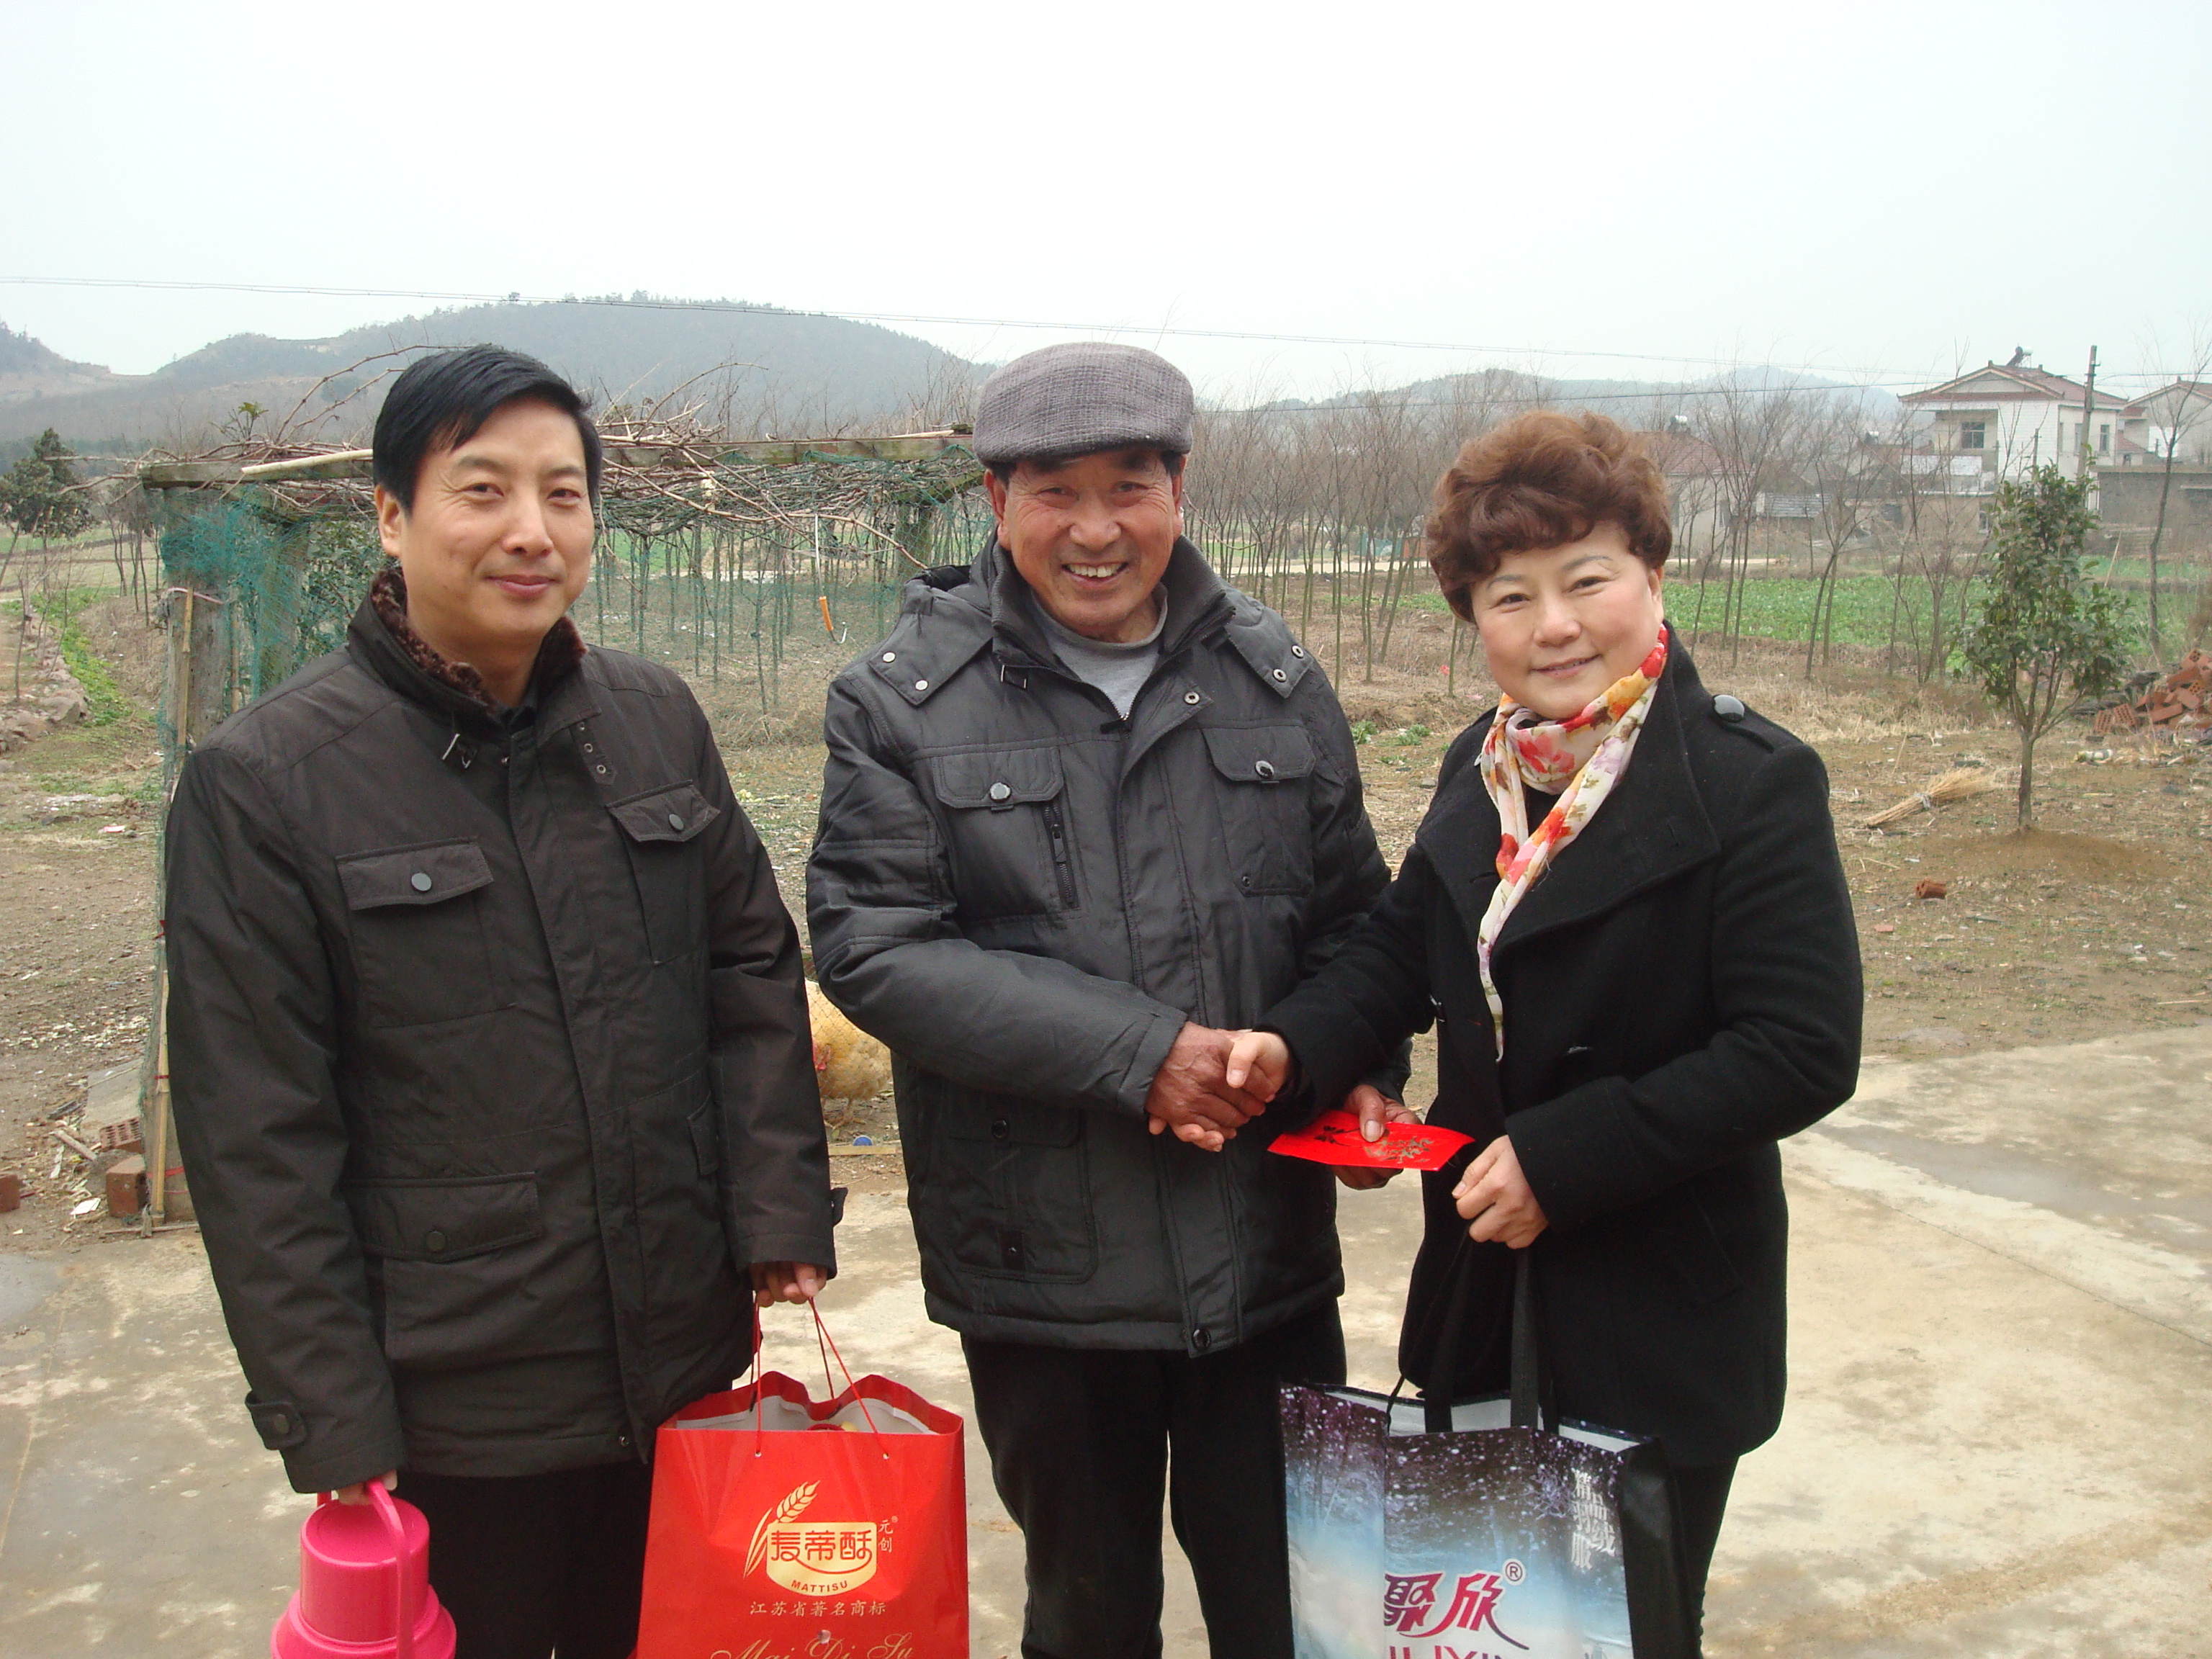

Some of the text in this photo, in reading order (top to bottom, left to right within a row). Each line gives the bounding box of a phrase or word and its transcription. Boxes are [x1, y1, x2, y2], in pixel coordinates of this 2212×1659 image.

[791, 1579, 848, 1593] MATTISU
[750, 1600, 886, 1618] 江苏省著名商标
[1384, 1573, 1530, 1650] 聚欣
